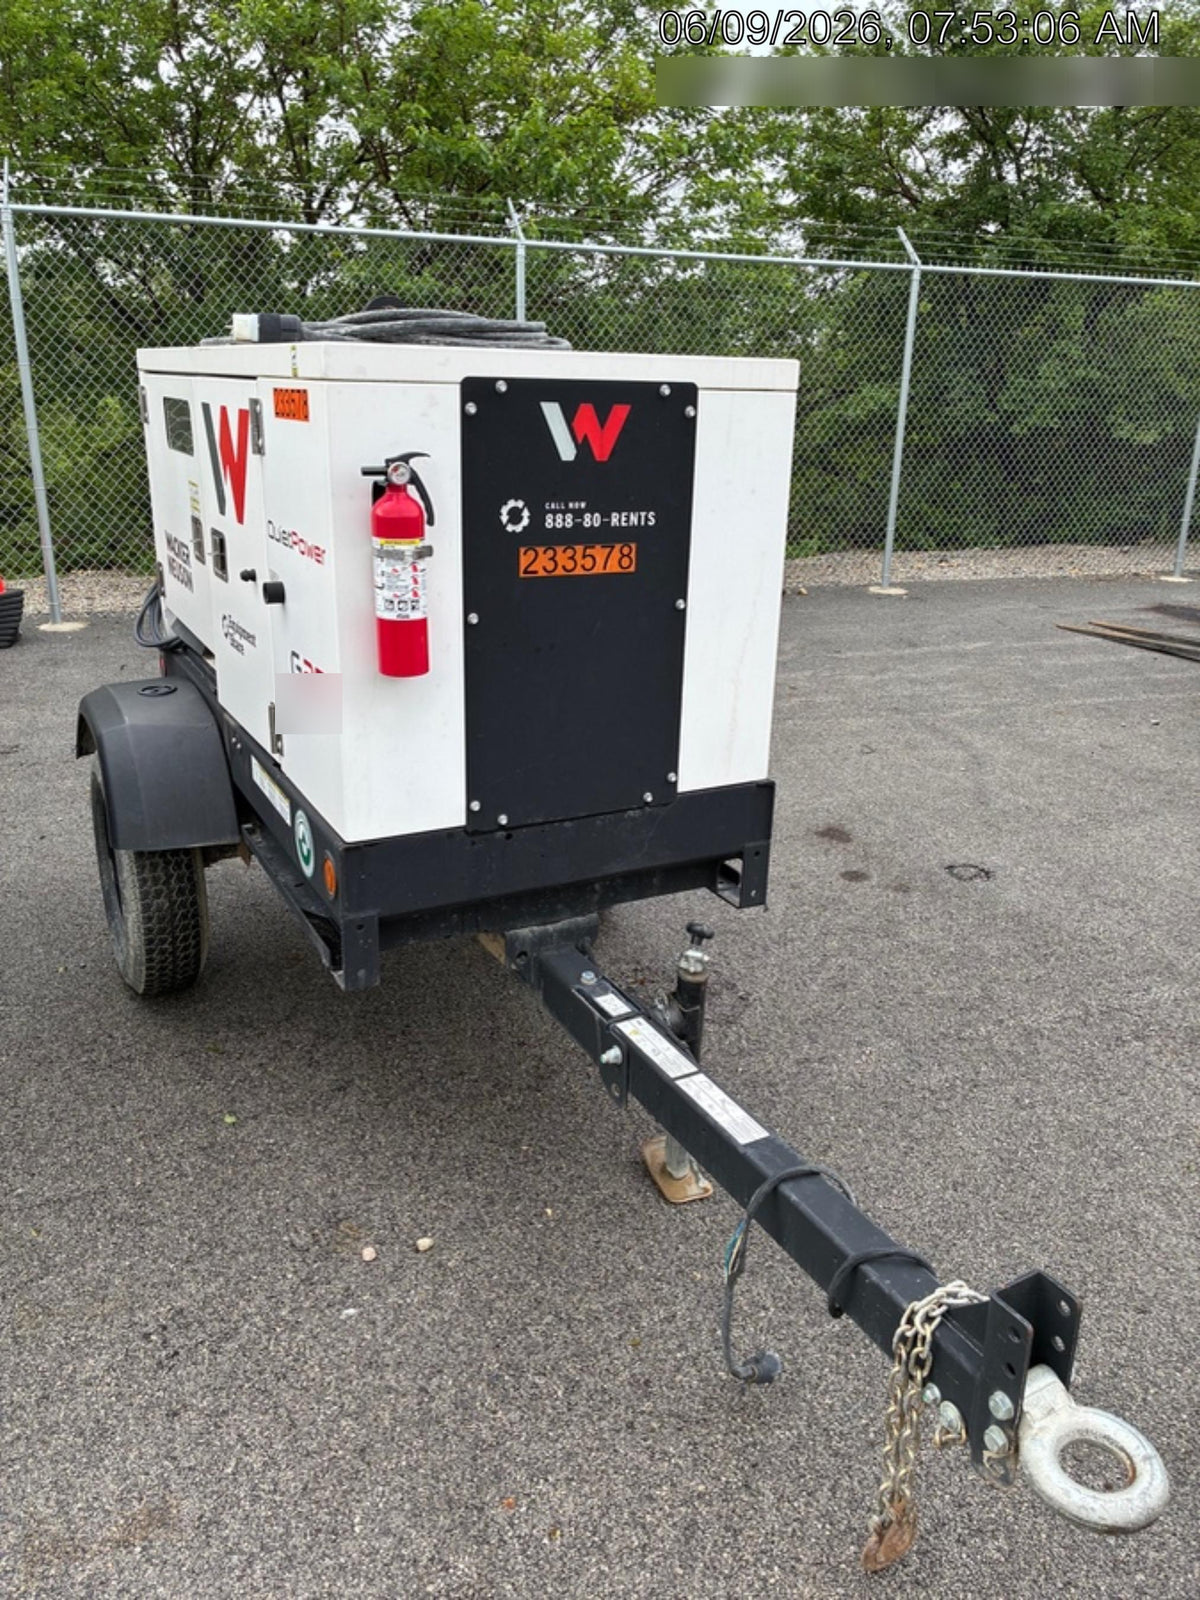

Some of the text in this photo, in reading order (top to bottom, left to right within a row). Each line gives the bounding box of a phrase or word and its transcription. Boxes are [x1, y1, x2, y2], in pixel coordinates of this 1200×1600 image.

[545, 501, 587, 510] CALL NOW
[545, 511, 656, 529] 888-80-RENTS
[522, 543, 634, 575] 233578
